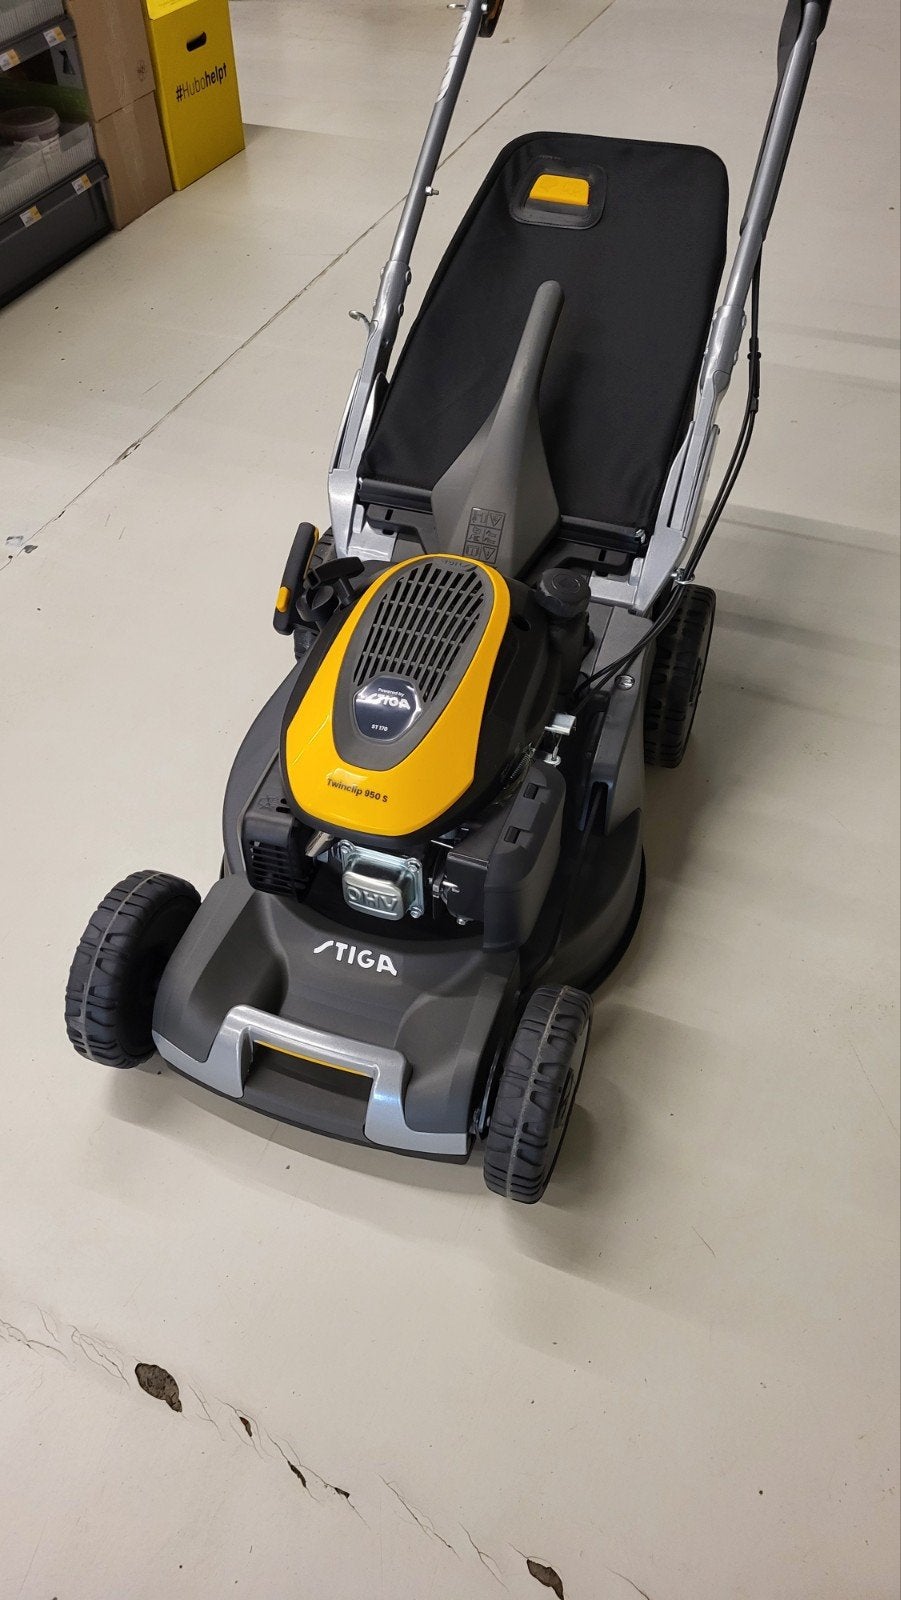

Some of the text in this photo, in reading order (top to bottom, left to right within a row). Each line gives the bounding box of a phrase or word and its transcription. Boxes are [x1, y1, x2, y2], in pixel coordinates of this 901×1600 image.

[176, 62, 227, 102] #Hubohelpt
[365, 693, 411, 710] STIGA
[377, 687, 398, 695] Powered
[327, 778, 388, 803] Twinclip 950 S
[347, 885, 398, 912] OHV
[313, 940, 398, 977] STIGA
